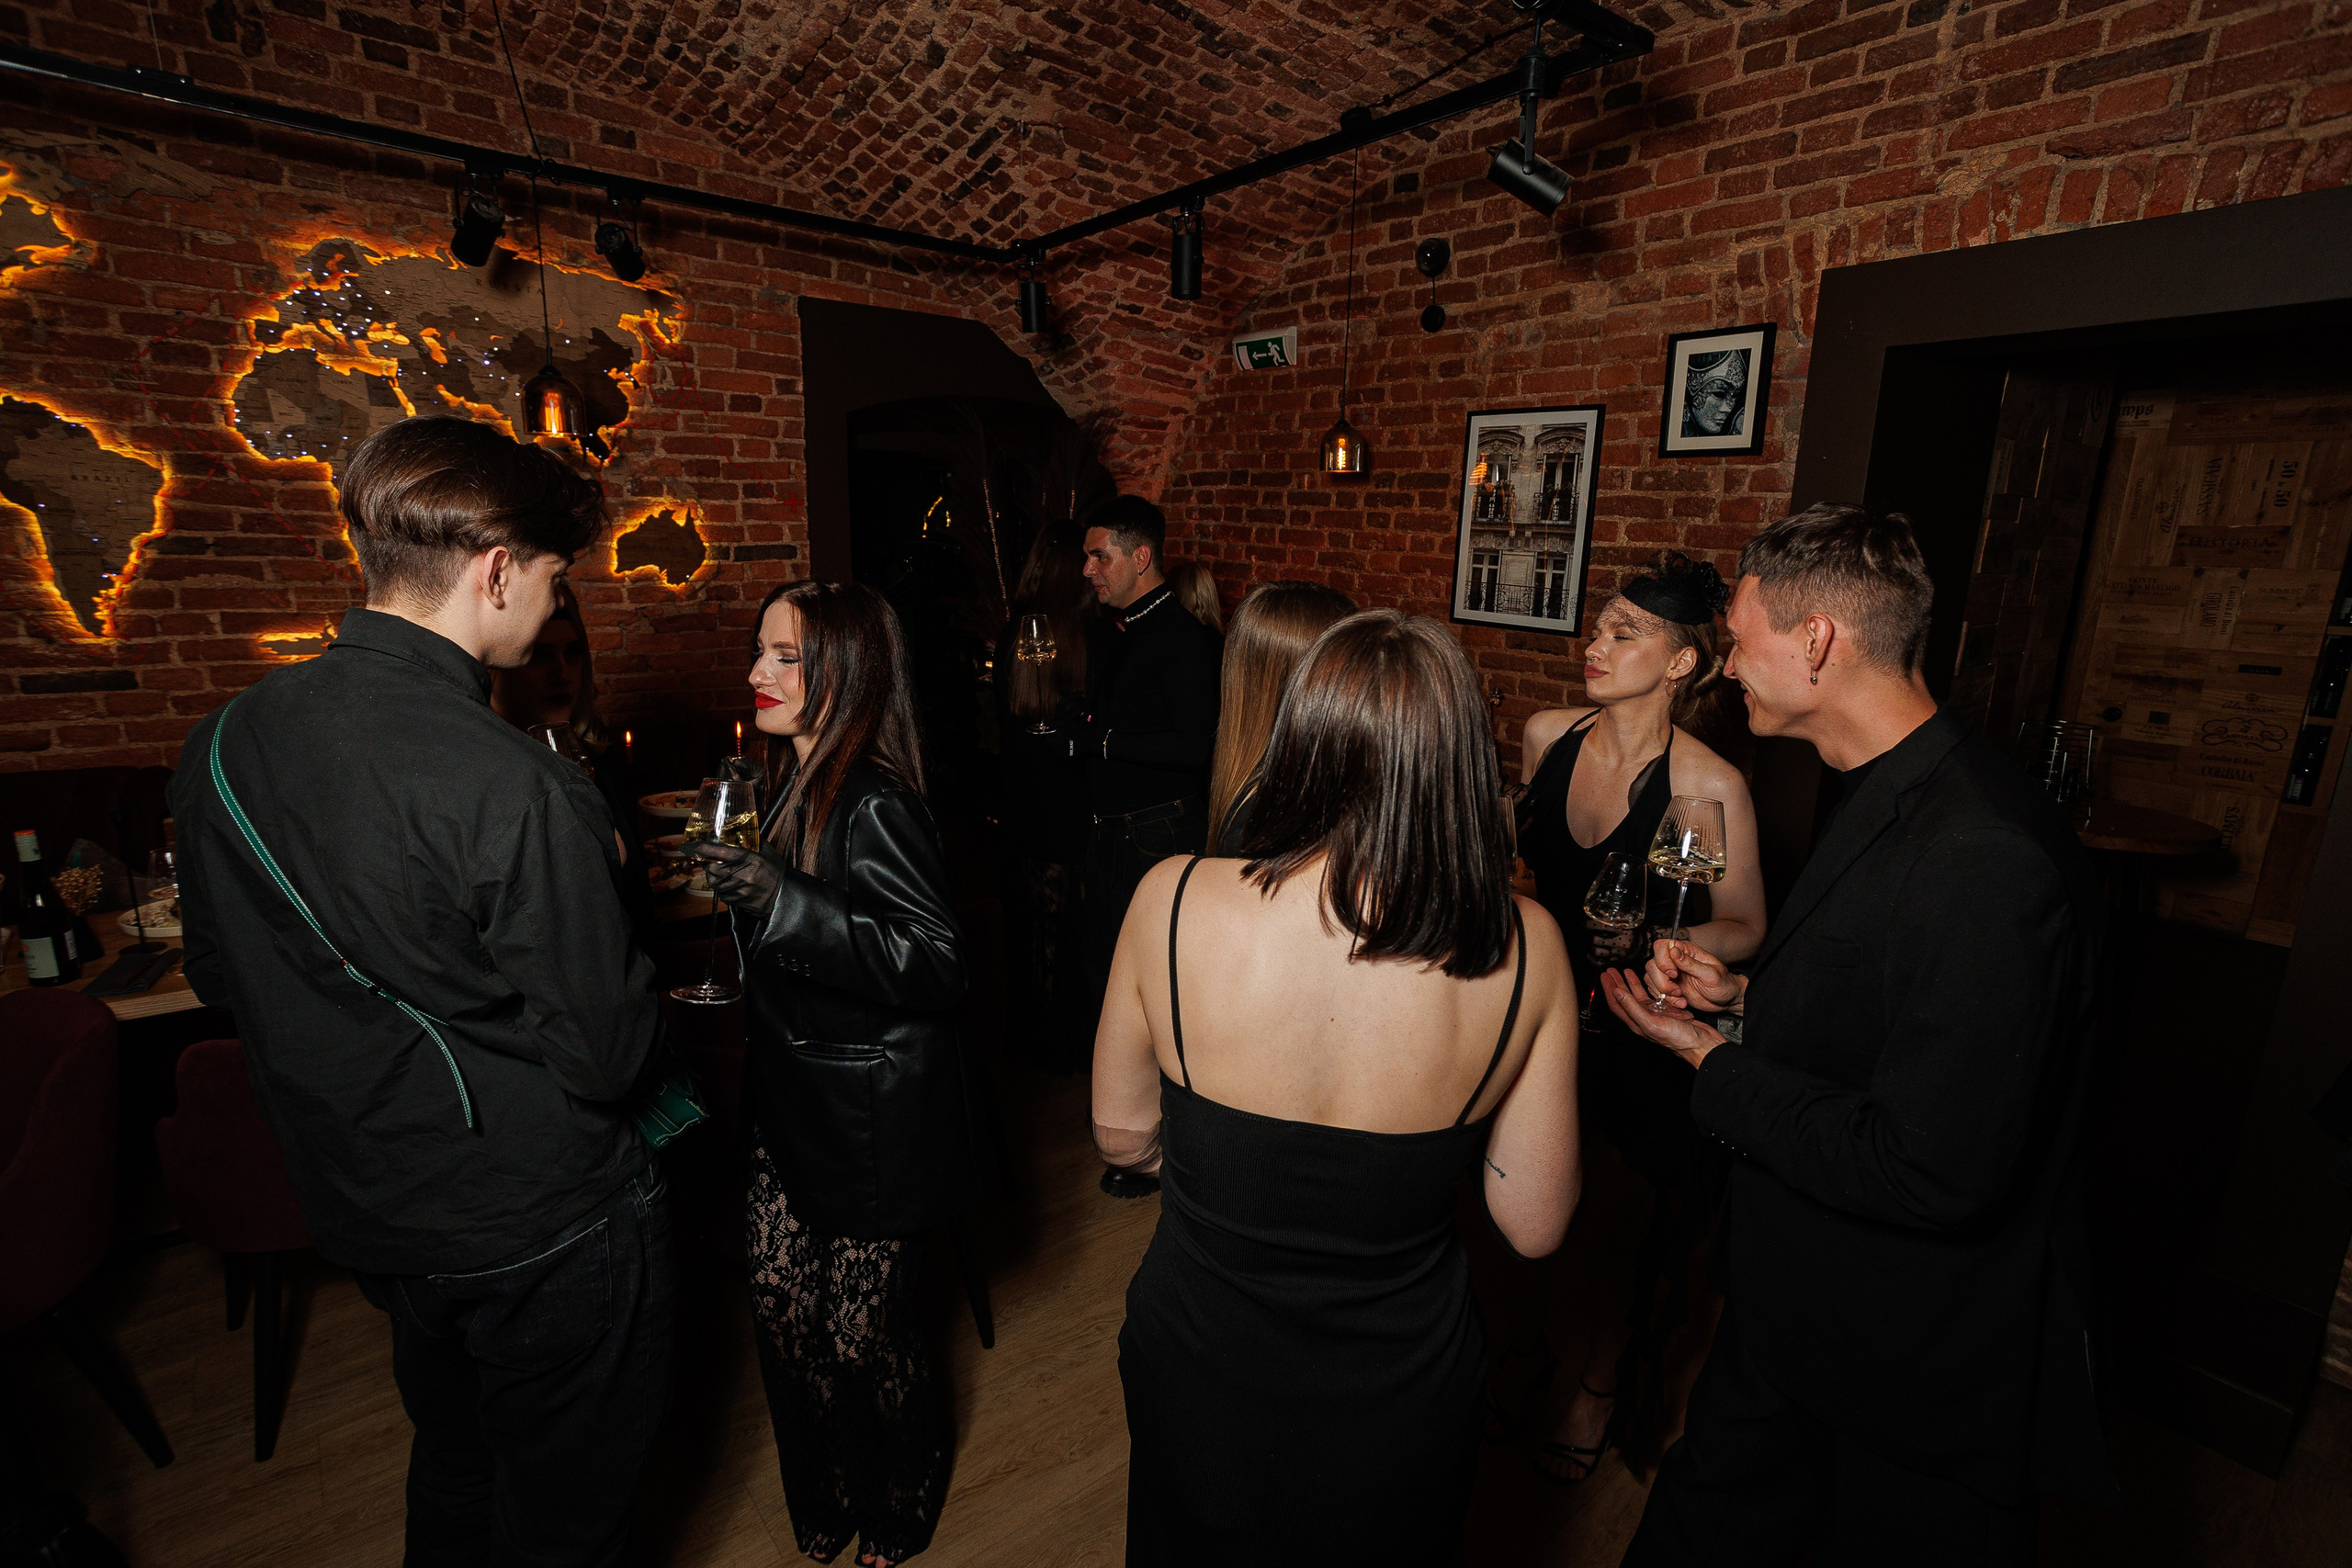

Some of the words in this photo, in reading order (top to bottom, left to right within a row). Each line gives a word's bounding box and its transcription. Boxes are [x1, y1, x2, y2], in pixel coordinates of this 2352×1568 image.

[475, 278, 544, 295] RUSSIA
[71, 474, 130, 482] BRAZIL
[2280, 461, 2300, 478] 50
[2196, 457, 2222, 515] SASSICAIA
[2273, 490, 2291, 507] 50
[2199, 592, 2222, 626] GIROLAMO
[2199, 752, 2233, 763] Castello
[2243, 758, 2265, 767] Bossi
